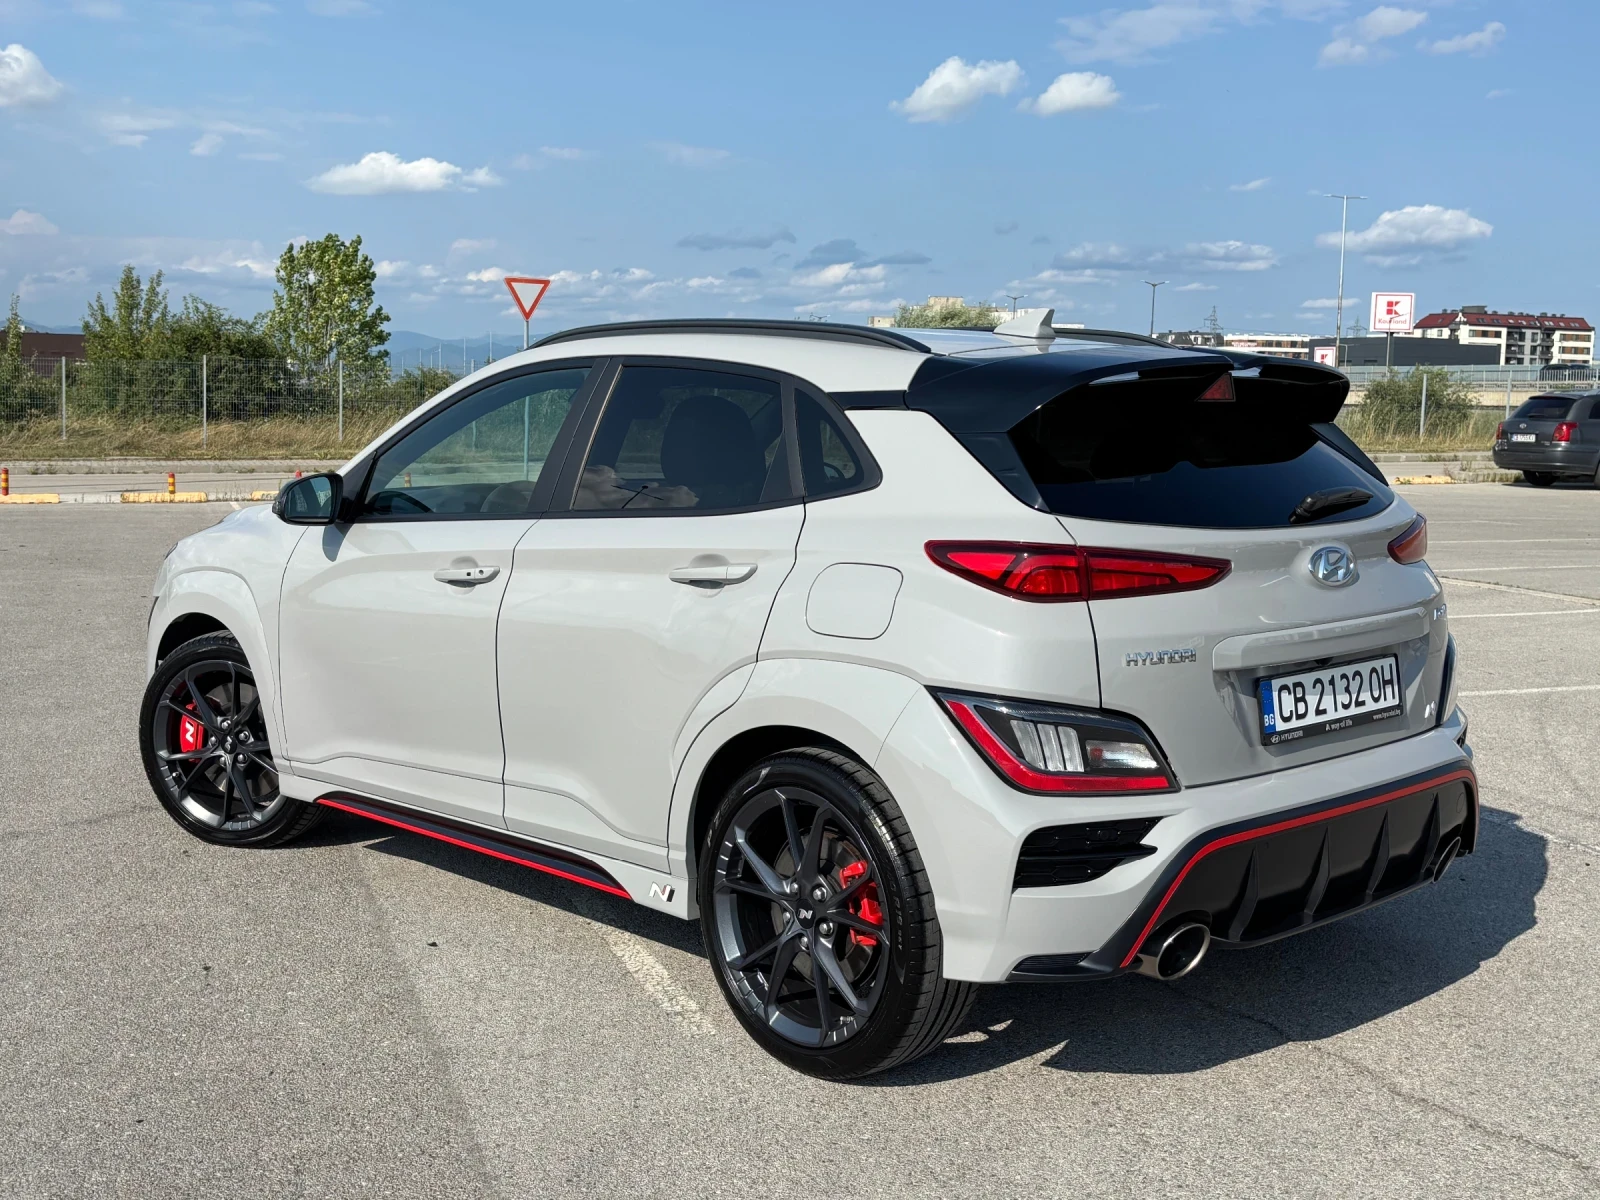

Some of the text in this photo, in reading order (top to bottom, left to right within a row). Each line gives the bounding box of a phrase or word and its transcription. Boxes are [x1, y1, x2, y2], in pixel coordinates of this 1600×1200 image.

[1378, 317, 1407, 325] Kauland
[1125, 648, 1197, 667] HYUNDAI
[1277, 681, 1309, 723] CB
[1312, 670, 1366, 717] 2132
[1264, 714, 1275, 727] BG
[1325, 723, 1331, 731] A
[1331, 722, 1341, 731] way
[1345, 719, 1353, 727] life
[1281, 730, 1304, 741] HYUNDAI
